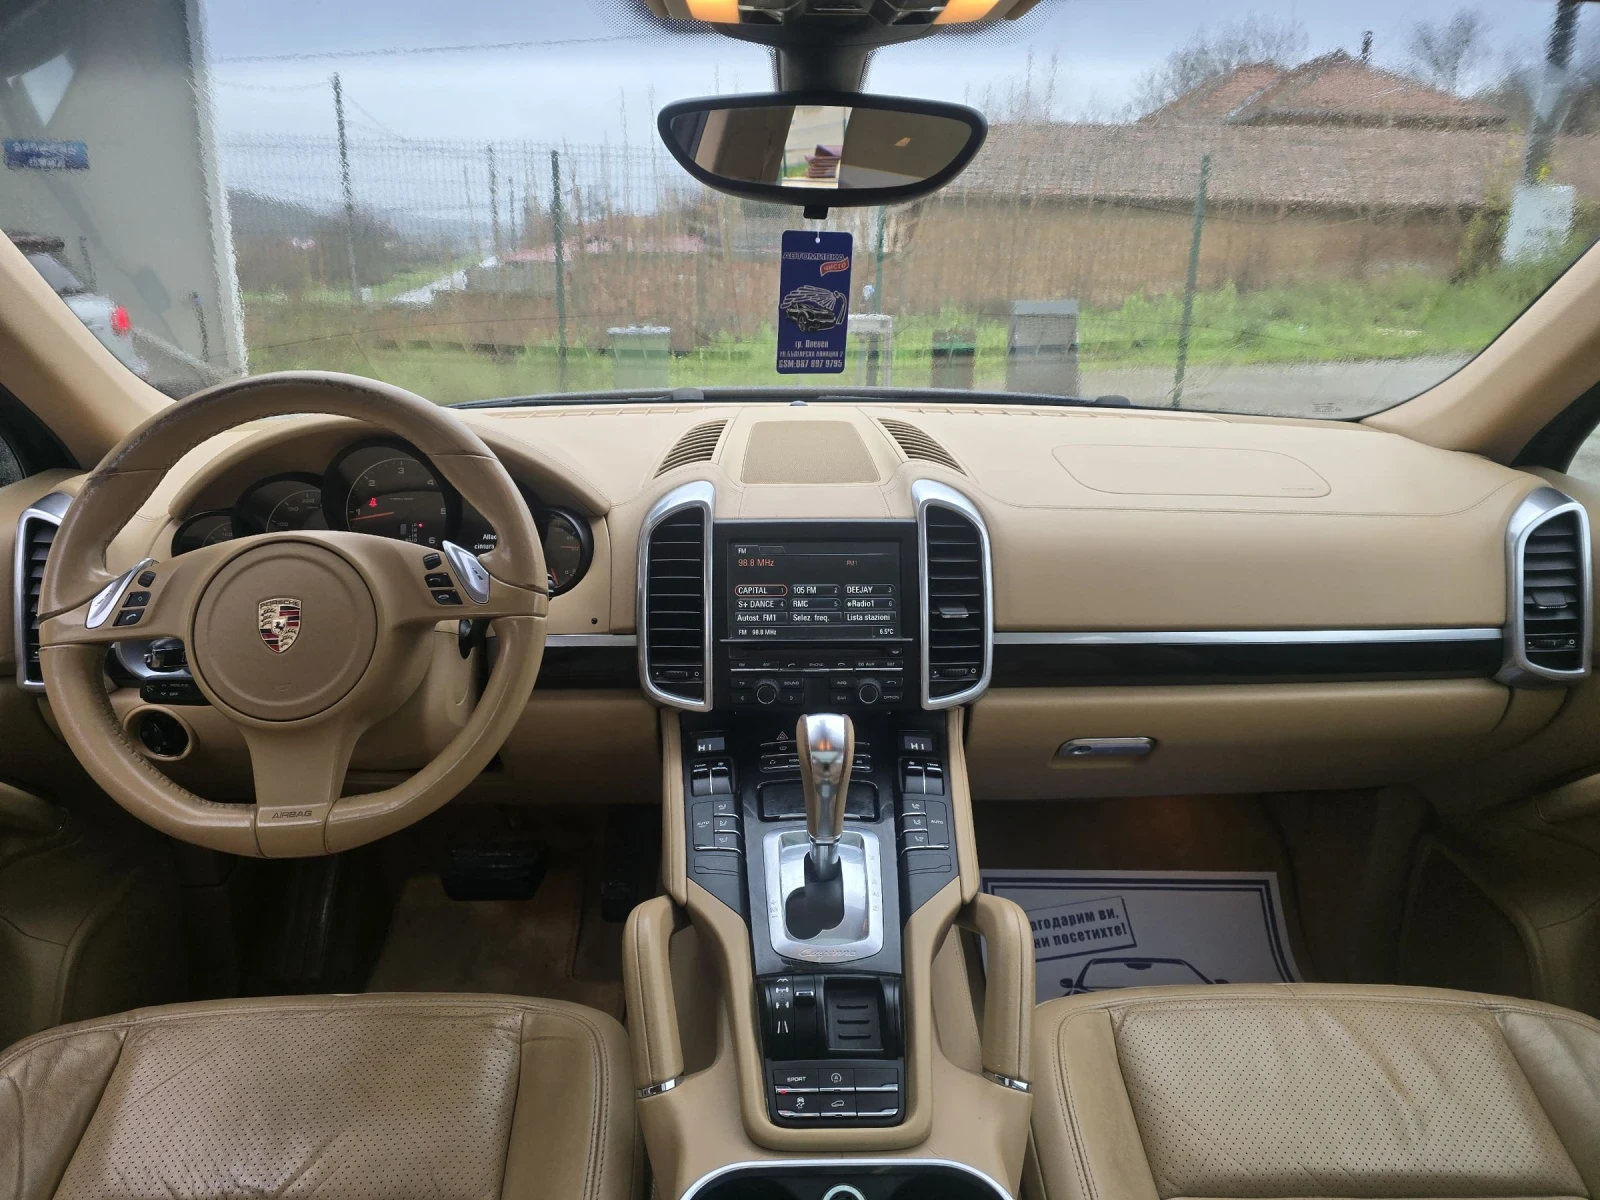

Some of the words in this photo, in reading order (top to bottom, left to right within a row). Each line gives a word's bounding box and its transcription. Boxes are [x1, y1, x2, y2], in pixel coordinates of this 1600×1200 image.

[782, 252, 845, 261] АВТОМИВКА
[823, 262, 847, 271] ЧИСТО
[825, 359, 843, 368] 9795
[397, 467, 405, 475] 3
[368, 479, 376, 487] 2
[355, 508, 361, 516] 1
[428, 536, 436, 544] 6
[738, 559, 755, 567] 98.8
[757, 559, 774, 567] MHz
[738, 587, 768, 595] CAPITAL
[846, 586, 873, 594] DEEJAY
[736, 614, 761, 622] Autost.
[762, 614, 777, 622] FM1
[814, 614, 830, 623] freq.
[846, 613, 863, 621] Lista
[865, 613, 891, 621] stazioni
[271, 810, 313, 820] AIRBAG
[1032, 912, 1096, 932] агодарим
[1098, 907, 1120, 921] ви,
[1053, 922, 1128, 947] посетихте!
